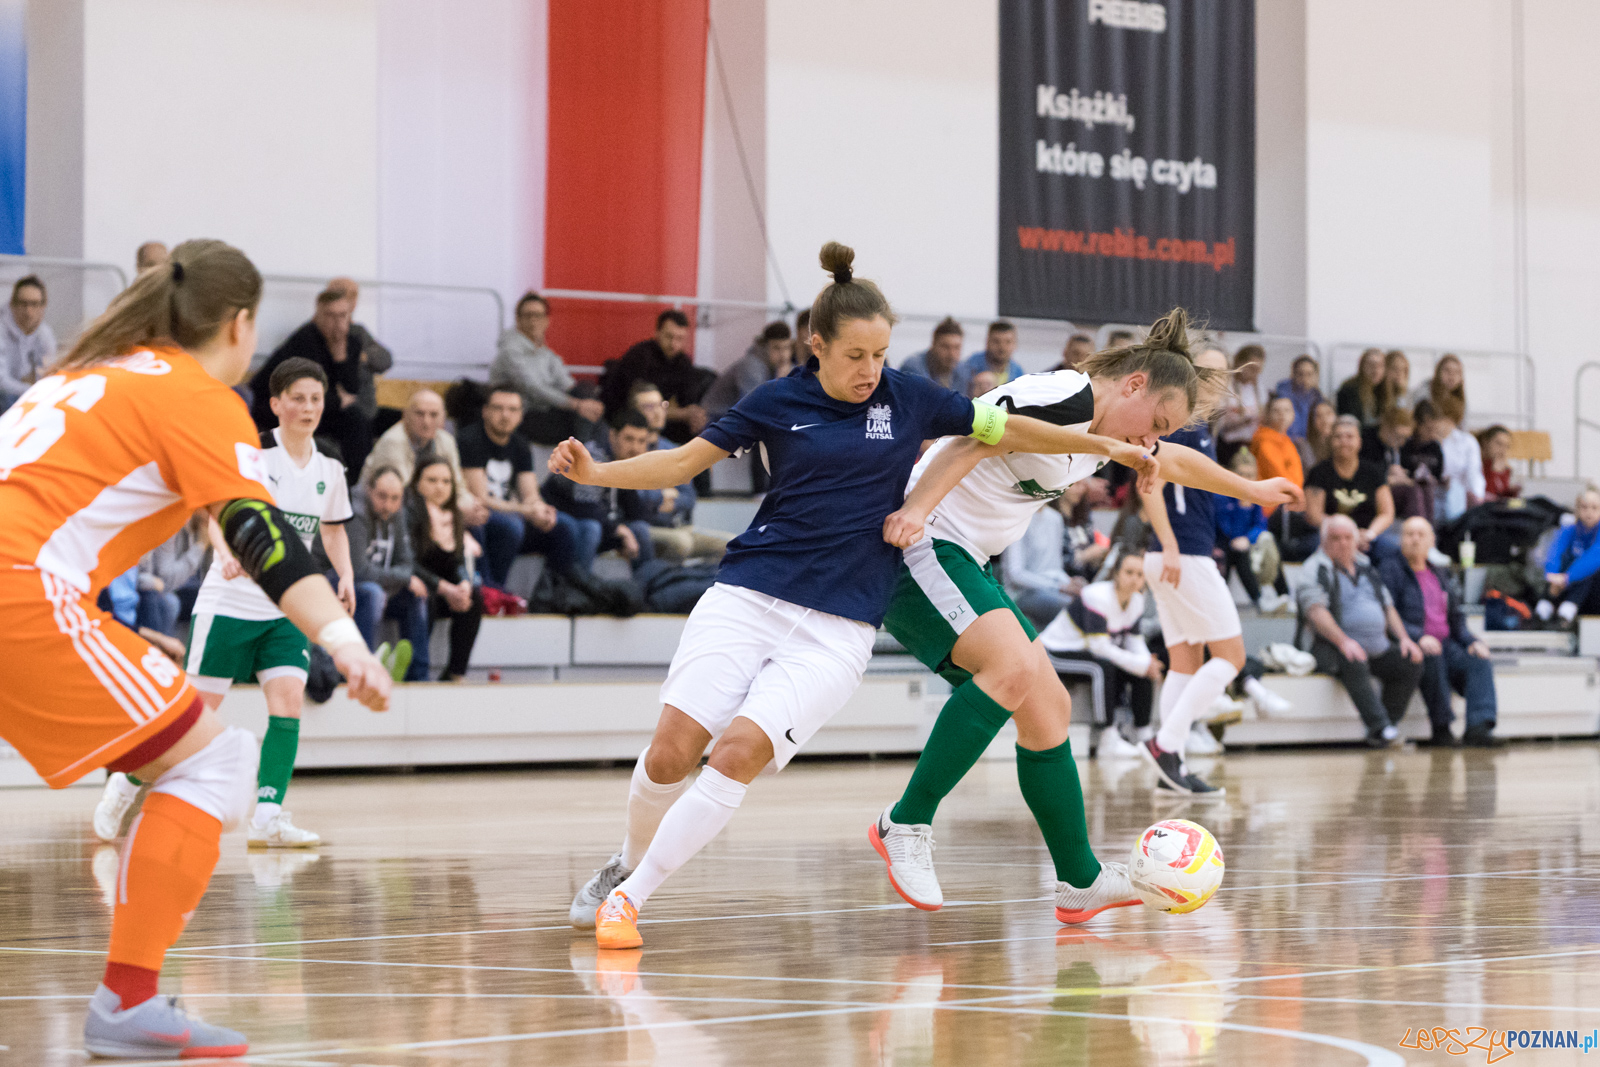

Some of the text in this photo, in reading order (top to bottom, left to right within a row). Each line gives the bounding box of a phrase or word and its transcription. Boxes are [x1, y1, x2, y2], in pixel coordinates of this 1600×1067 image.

[1088, 0, 1167, 32] REBIS
[1037, 84, 1135, 132] Książki,
[1036, 139, 1218, 193] które się czyta
[1018, 225, 1235, 272] www.rebis.com.pl
[865, 432, 895, 440] FUTSAL
